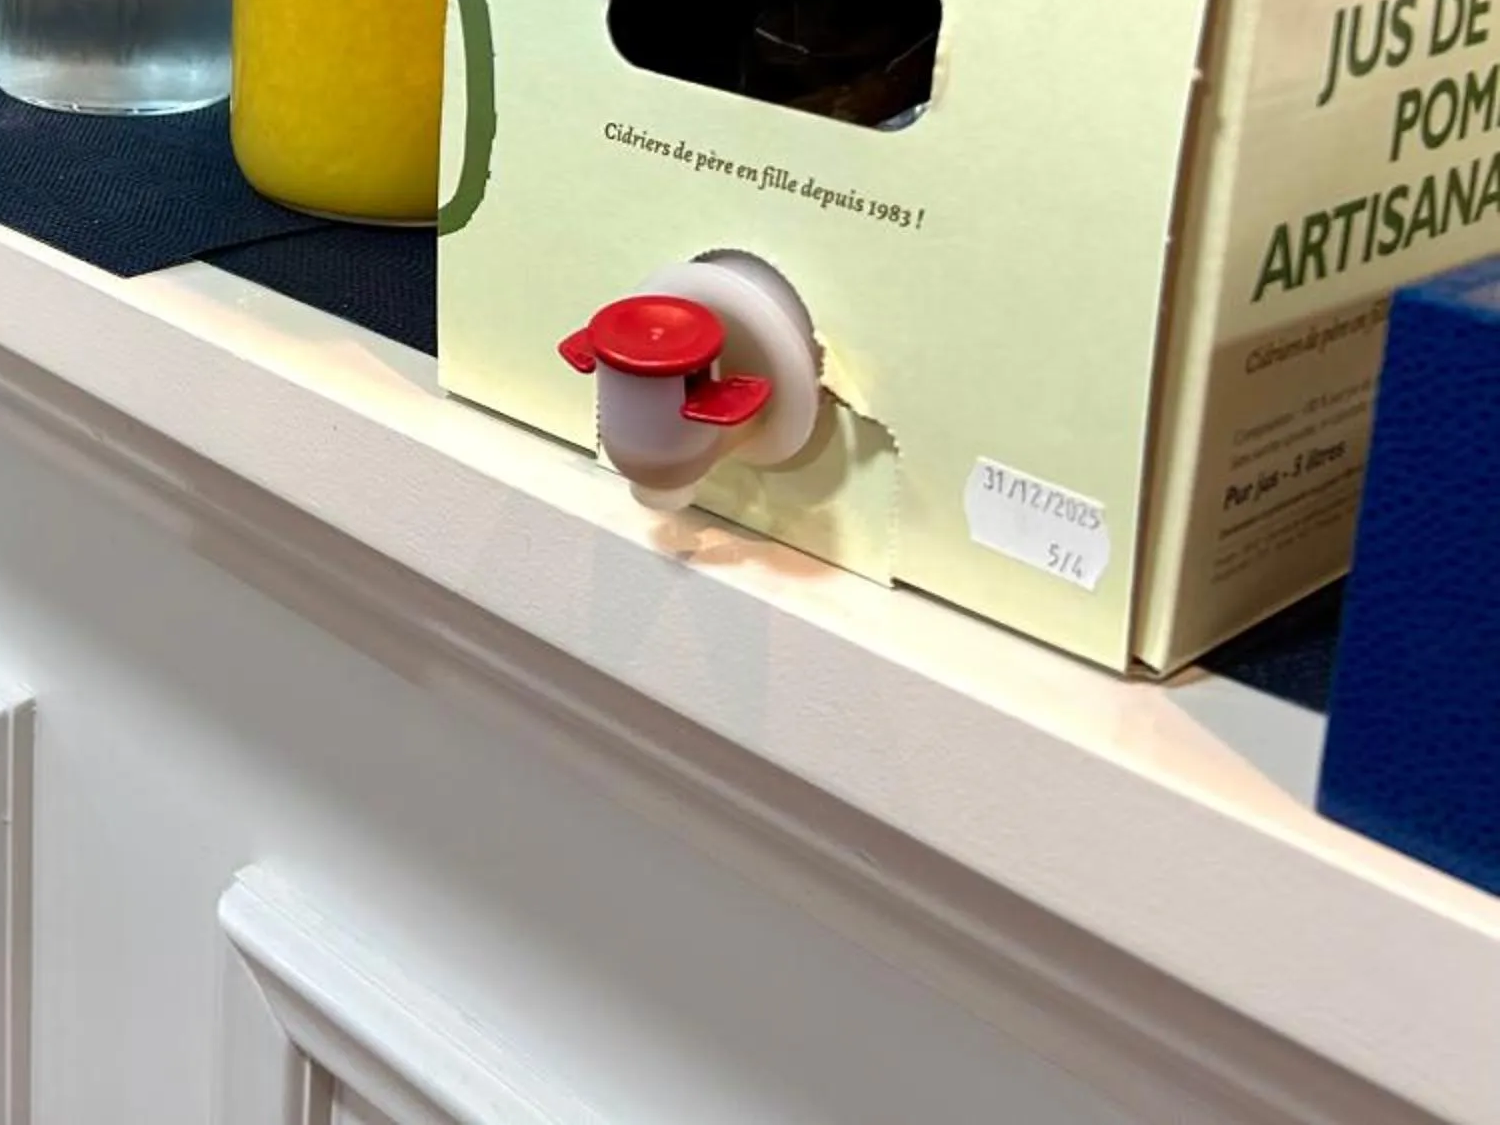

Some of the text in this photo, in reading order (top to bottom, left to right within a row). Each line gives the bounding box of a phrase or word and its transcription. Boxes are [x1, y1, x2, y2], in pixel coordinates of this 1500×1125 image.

[1390, 63, 1500, 163] POM
[604, 122, 671, 157] Cidriers
[673, 141, 693, 163] de
[695, 150, 734, 175] père
[736, 164, 757, 182] en
[757, 166, 797, 194] fille
[800, 177, 865, 212] depuis
[867, 201, 912, 229] 1983
[1047, 542, 1084, 580] 5/4
